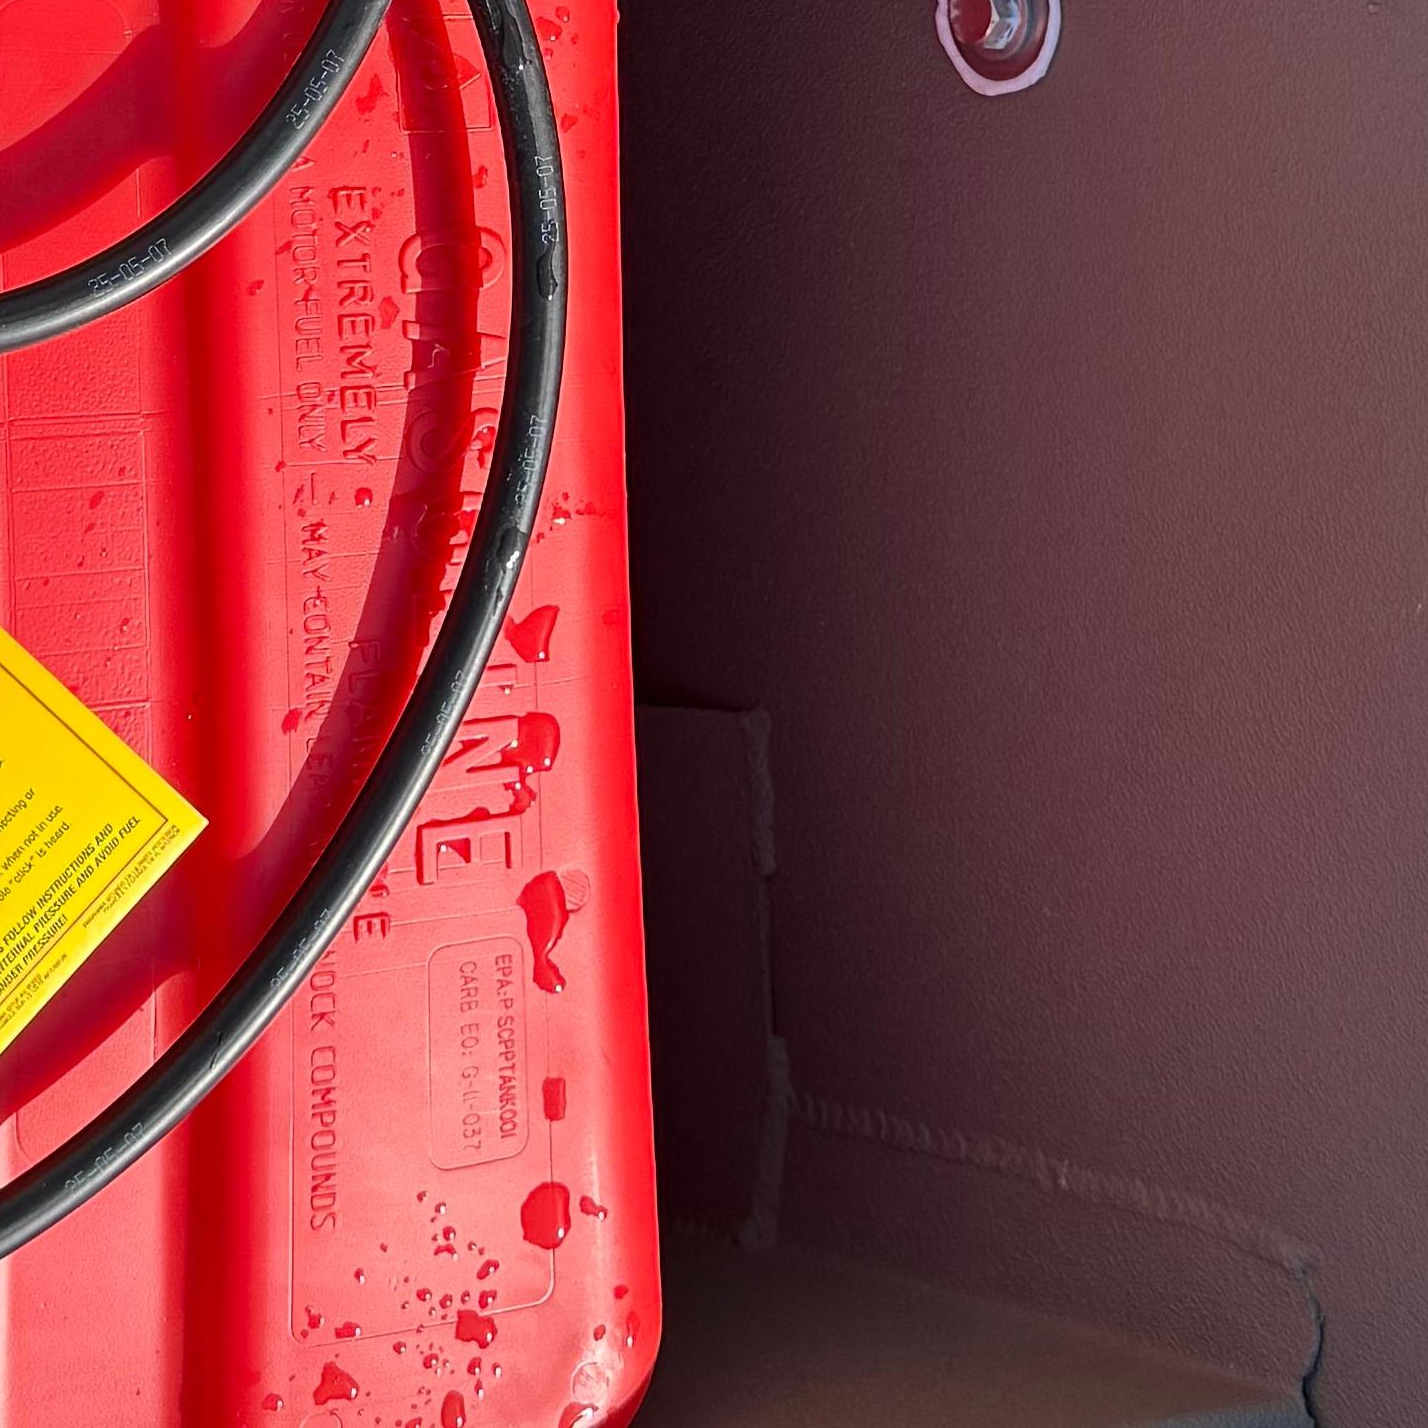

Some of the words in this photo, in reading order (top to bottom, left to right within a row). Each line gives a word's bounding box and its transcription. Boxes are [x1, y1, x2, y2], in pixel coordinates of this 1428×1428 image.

[286, 49, 344, 129] 25-05-07
[537, 155, 561, 245] 25-05-07
[87, 237, 170, 298] 25-05-07
[330, 185, 377, 465] EXTREMELY
[301, 520, 332, 583] MAY
[303, 596, 333, 724] CONTAIN
[459, 961, 479, 1013] CARB
[310, 1045, 337, 1232] COMPOUNDS
